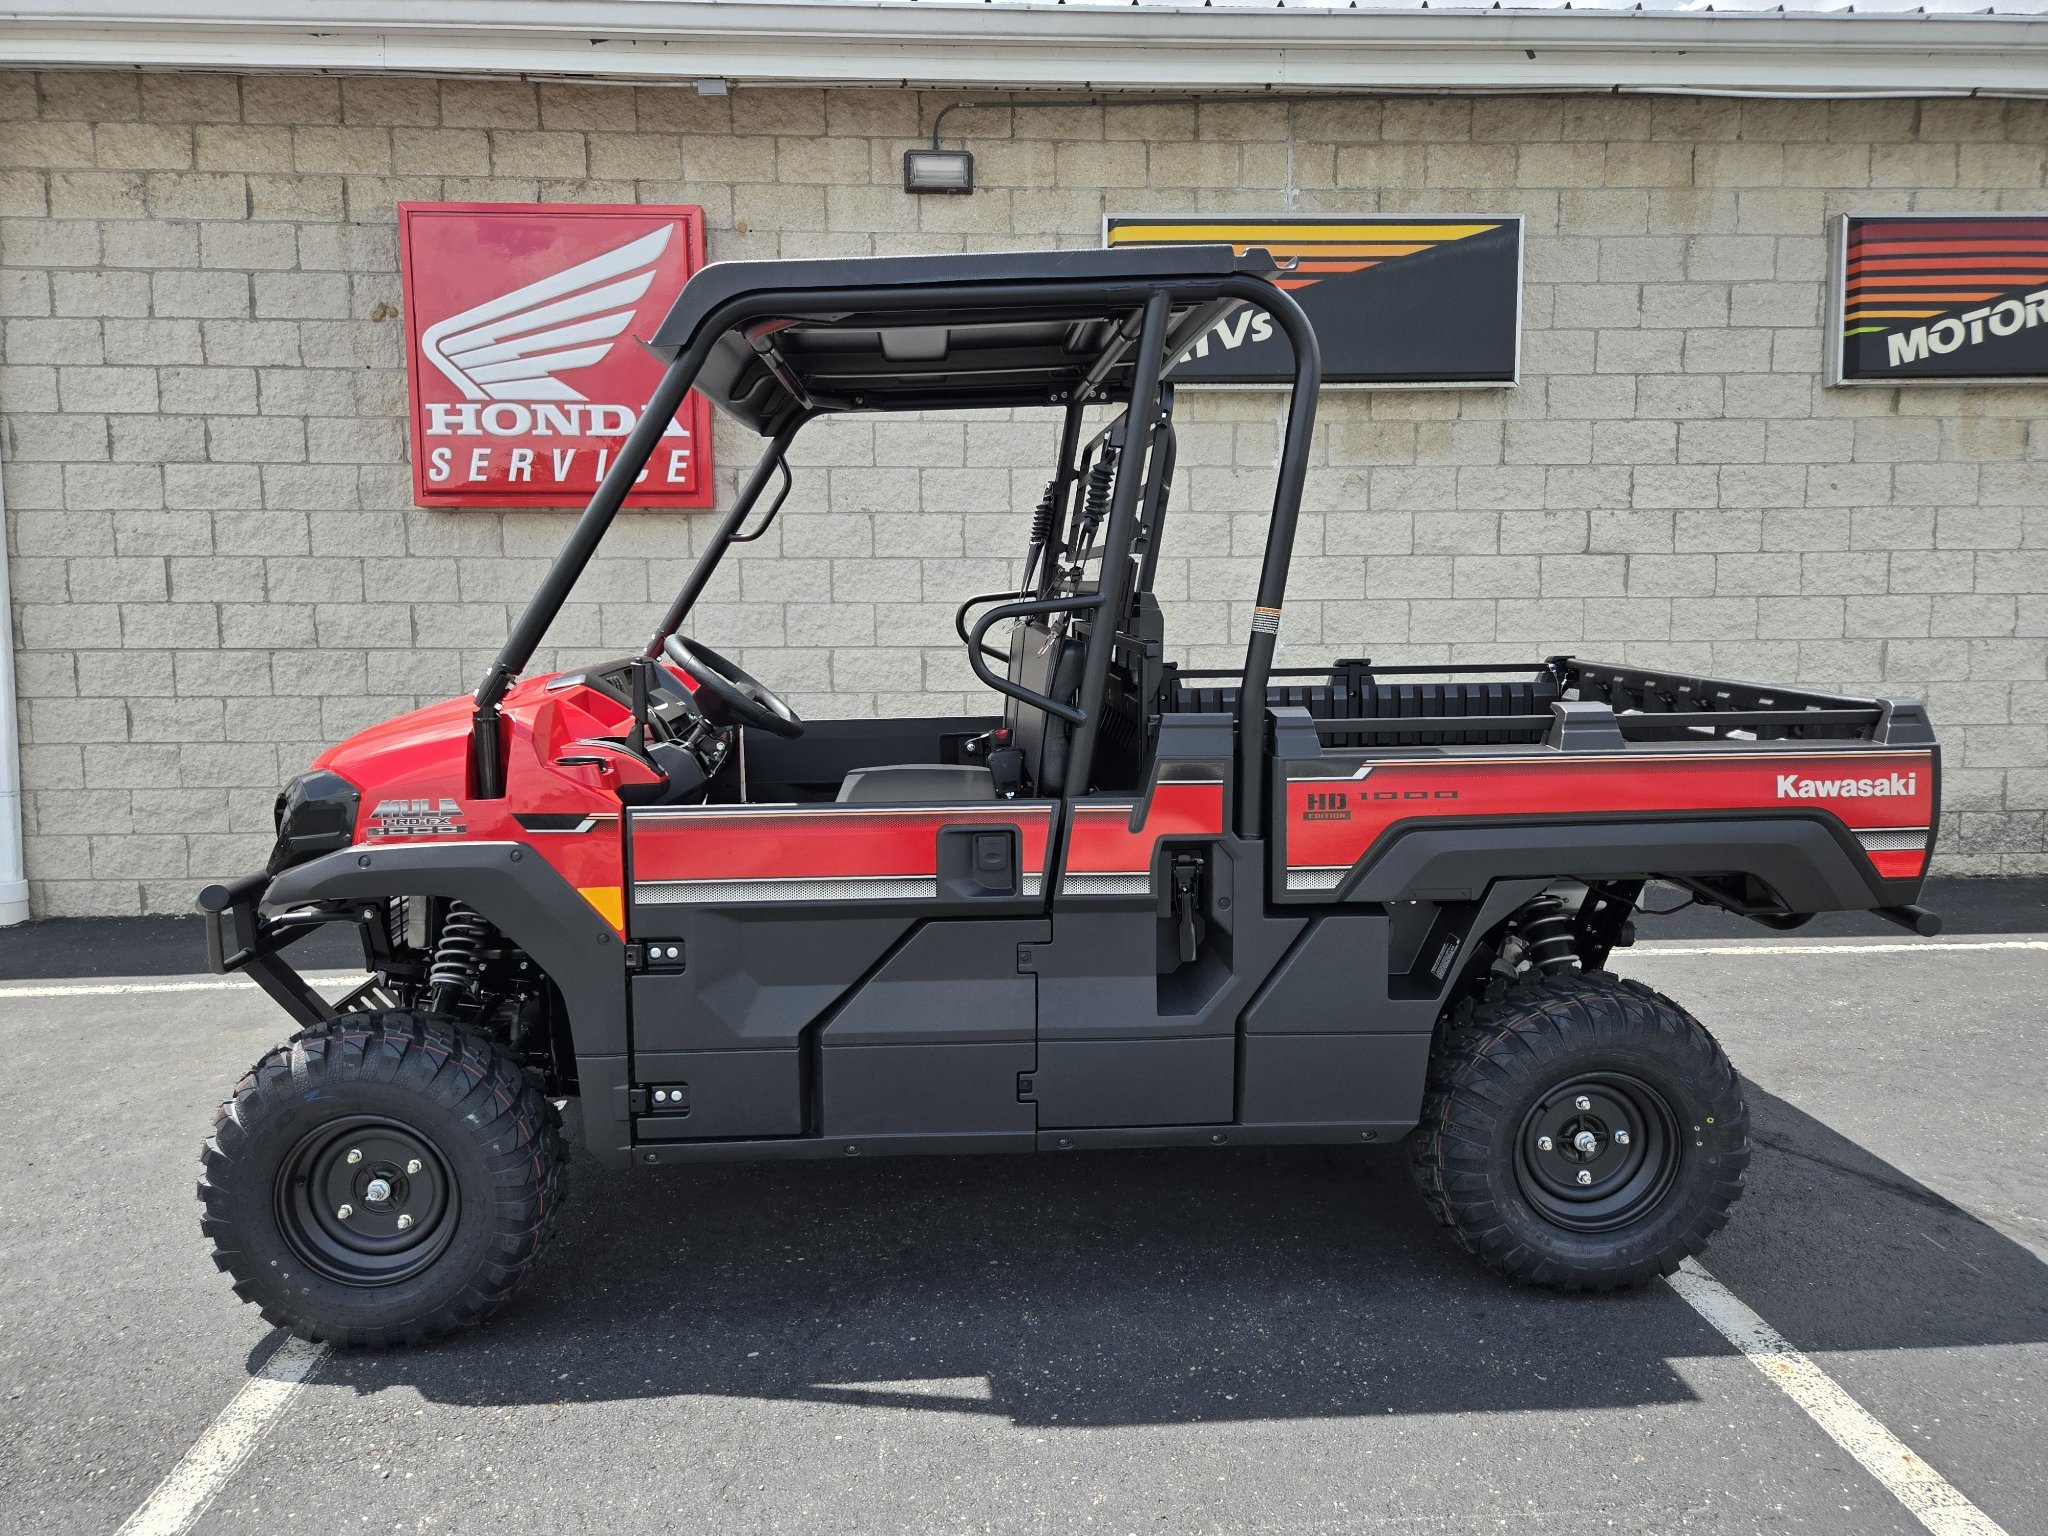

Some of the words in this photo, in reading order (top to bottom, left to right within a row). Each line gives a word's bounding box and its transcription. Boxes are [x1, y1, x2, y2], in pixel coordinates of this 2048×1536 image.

[1777, 773, 1916, 798] Kawasaki
[369, 798, 464, 819] MULE
[1307, 793, 1347, 810] HD
[1358, 791, 1459, 800] 1000
[1307, 812, 1347, 820] EDITION
